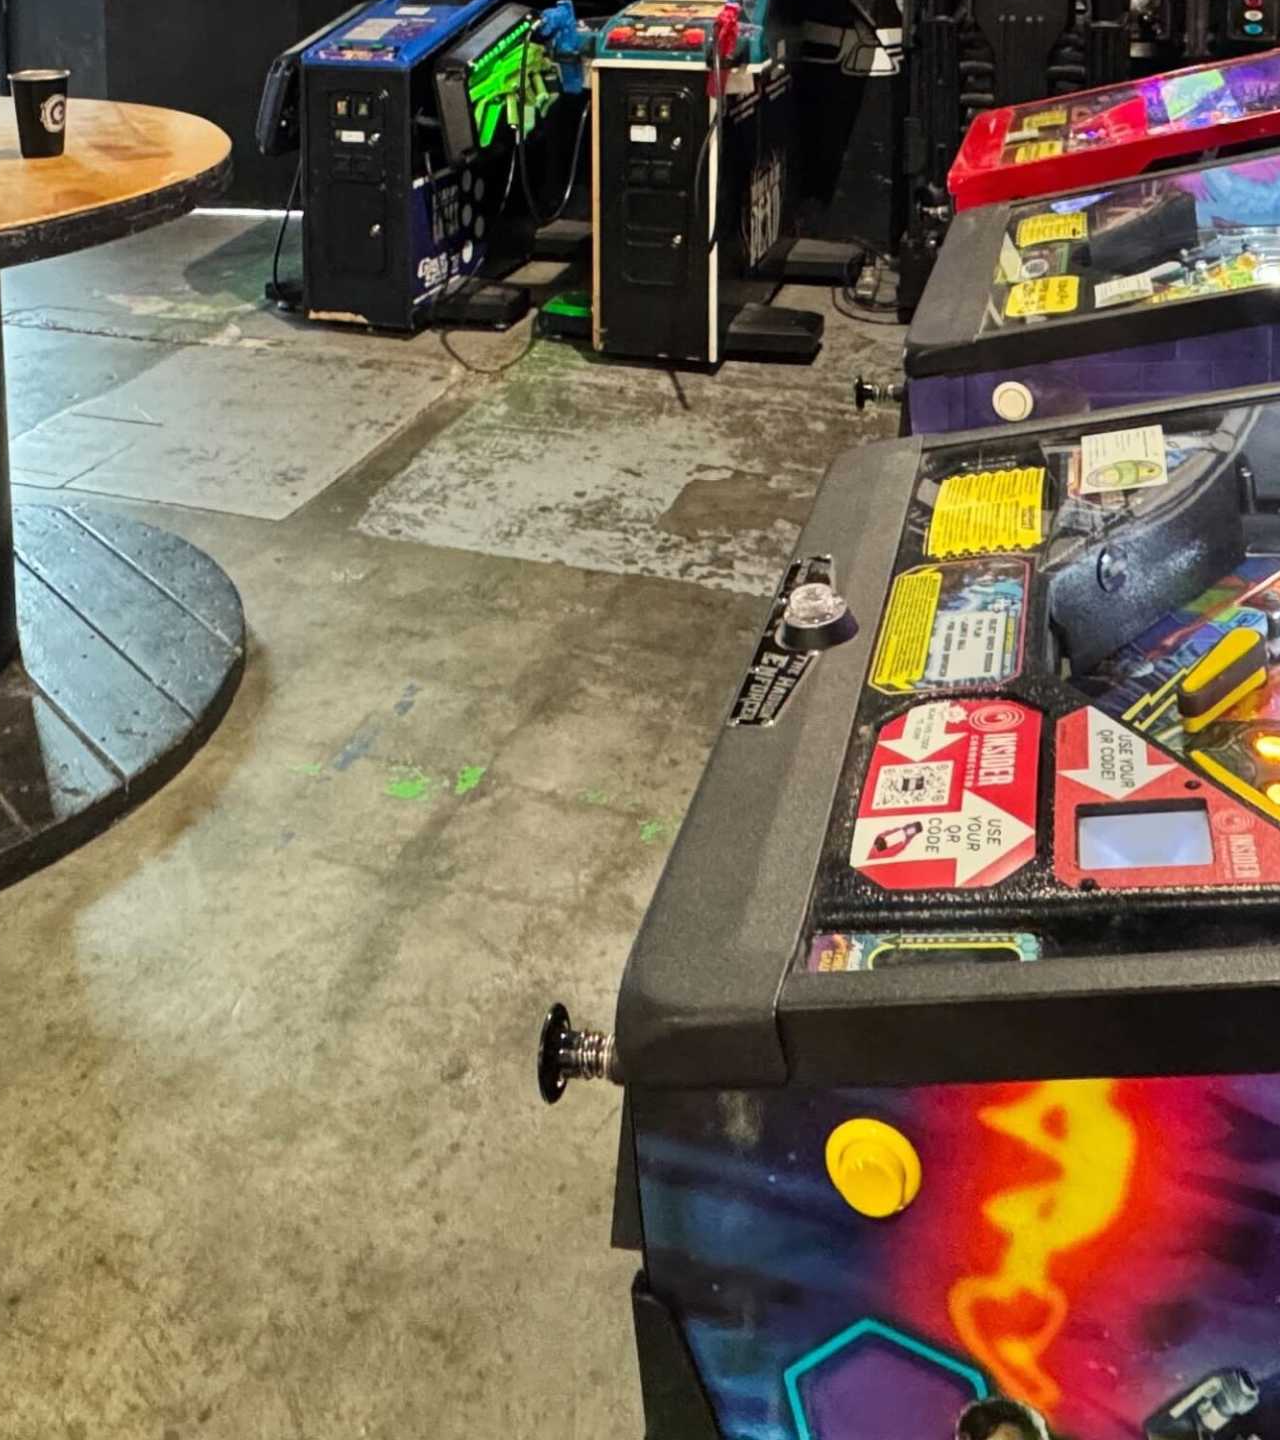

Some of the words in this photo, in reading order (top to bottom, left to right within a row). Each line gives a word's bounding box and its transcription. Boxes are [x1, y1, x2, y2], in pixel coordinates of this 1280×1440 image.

[1097, 729, 1112, 744] QR
[1118, 734, 1134, 755] USE
[964, 734, 979, 788] CONNECTED
[977, 732, 1018, 788] INSIDER
[1119, 759, 1135, 788] YOUR
[925, 817, 942, 854] CODE
[944, 824, 961, 844] QR
[966, 816, 983, 852] YOUR
[986, 819, 1002, 846] USE
[1230, 833, 1261, 879] INSIDER
